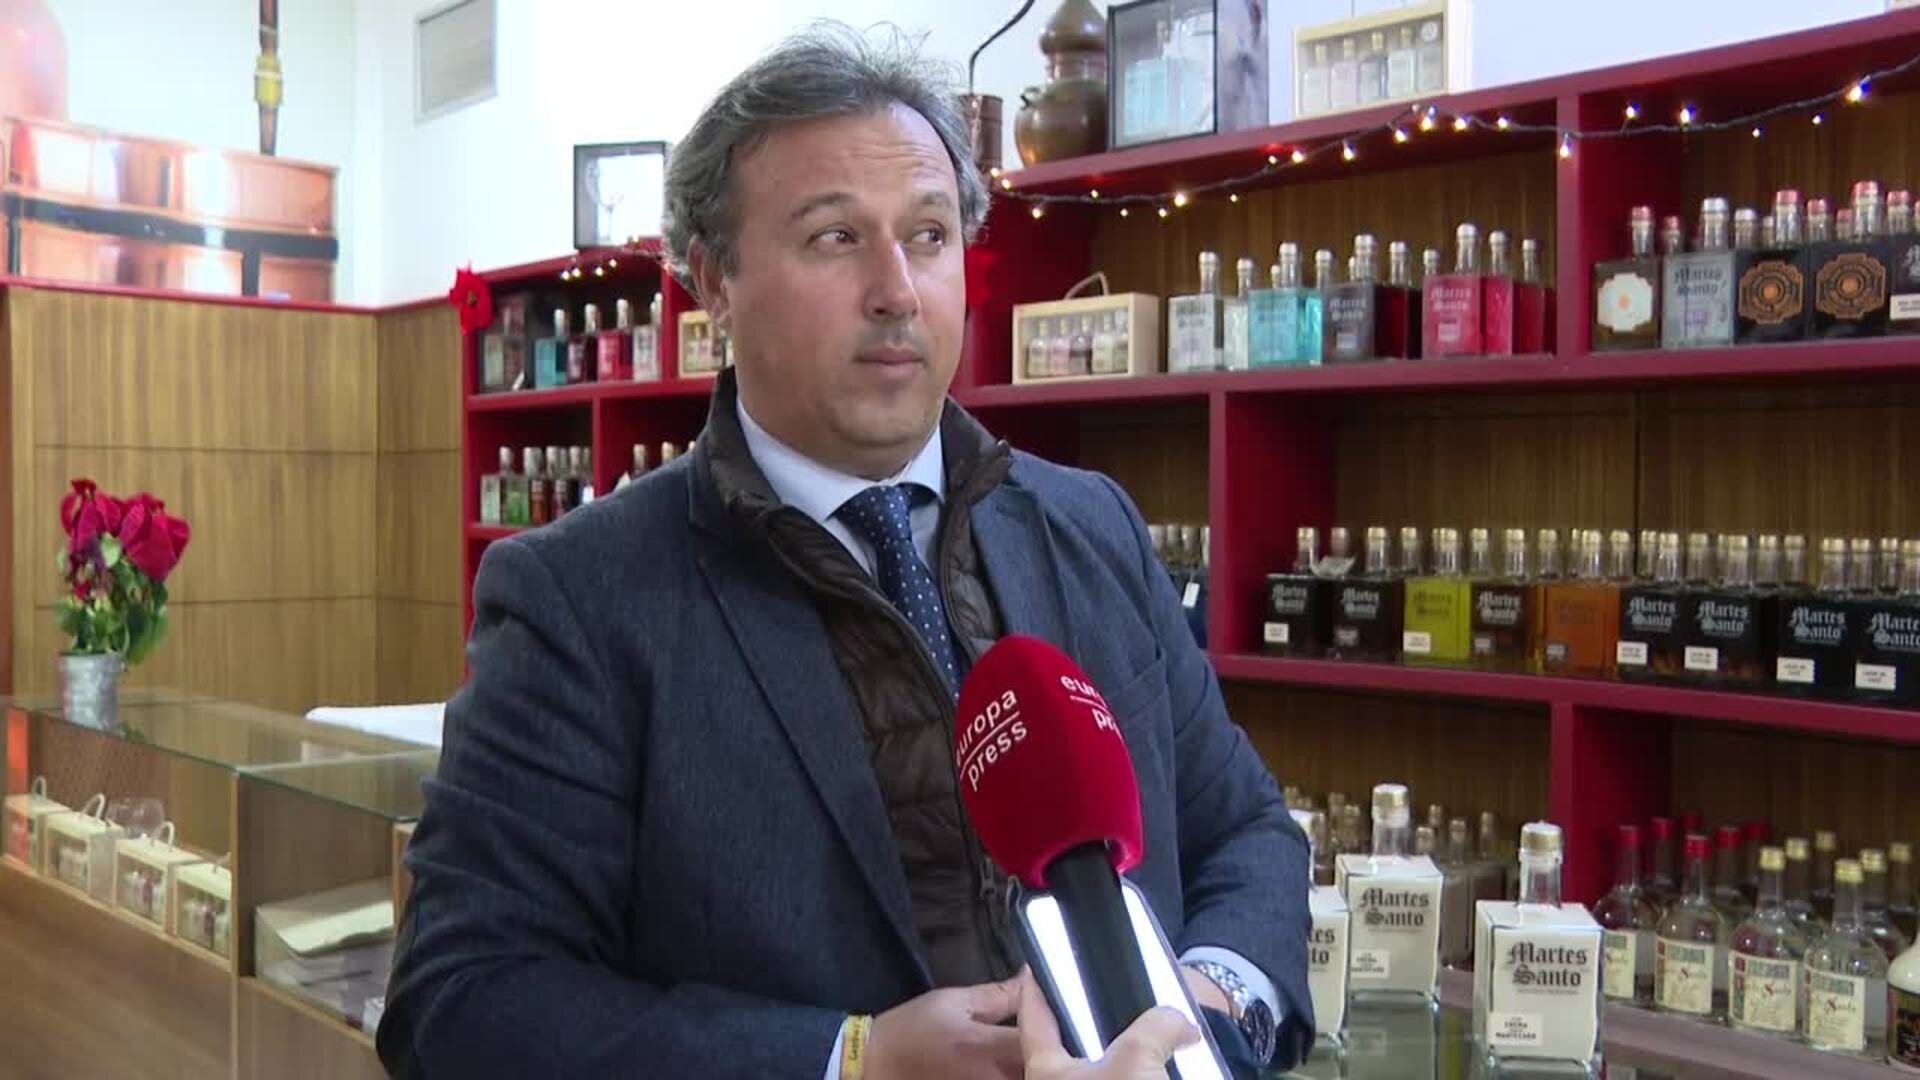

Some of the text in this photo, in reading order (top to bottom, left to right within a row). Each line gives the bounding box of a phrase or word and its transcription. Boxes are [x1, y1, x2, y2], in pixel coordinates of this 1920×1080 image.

[1626, 596, 1676, 616] Martes
[1697, 600, 1749, 620] Martes
[1789, 606, 1846, 627] Martes
[1701, 615, 1746, 632] Santo
[1793, 621, 1842, 640] Santo
[957, 689, 1018, 768] uropa
[967, 720, 1028, 793] press
[1359, 887, 1430, 908] Martes
[1364, 906, 1425, 928] Santo
[1506, 941, 1588, 966] Martes
[1511, 963, 1582, 987] Santo
